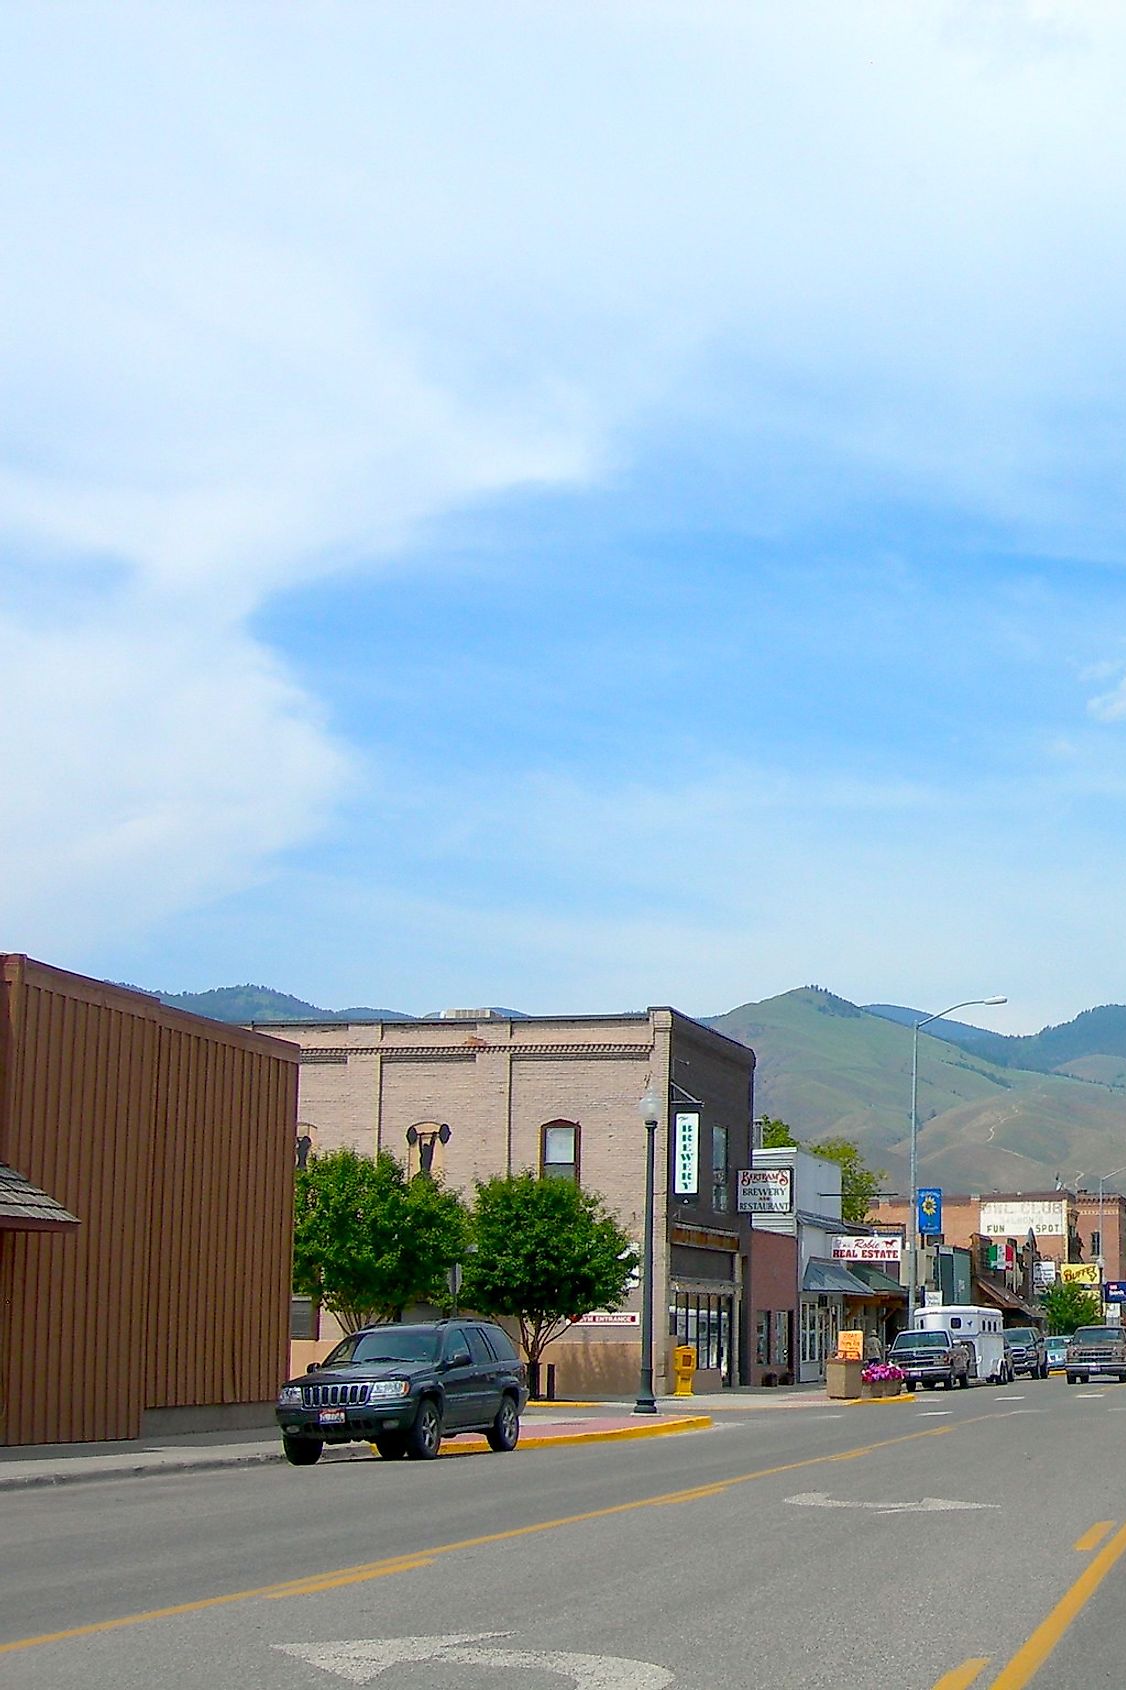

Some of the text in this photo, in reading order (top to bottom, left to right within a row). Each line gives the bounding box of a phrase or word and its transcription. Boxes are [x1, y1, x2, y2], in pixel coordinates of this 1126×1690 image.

[681, 1125, 694, 1190] BREWERY
[742, 1187, 786, 1196] BREWERY
[739, 1202, 788, 1210] RESTAURANT
[986, 1223, 1060, 1233] FUN SPOT
[854, 1239, 880, 1249] Robie
[832, 1249, 899, 1259] REAL ESTATE
[595, 1315, 631, 1323] ENTRANCE
